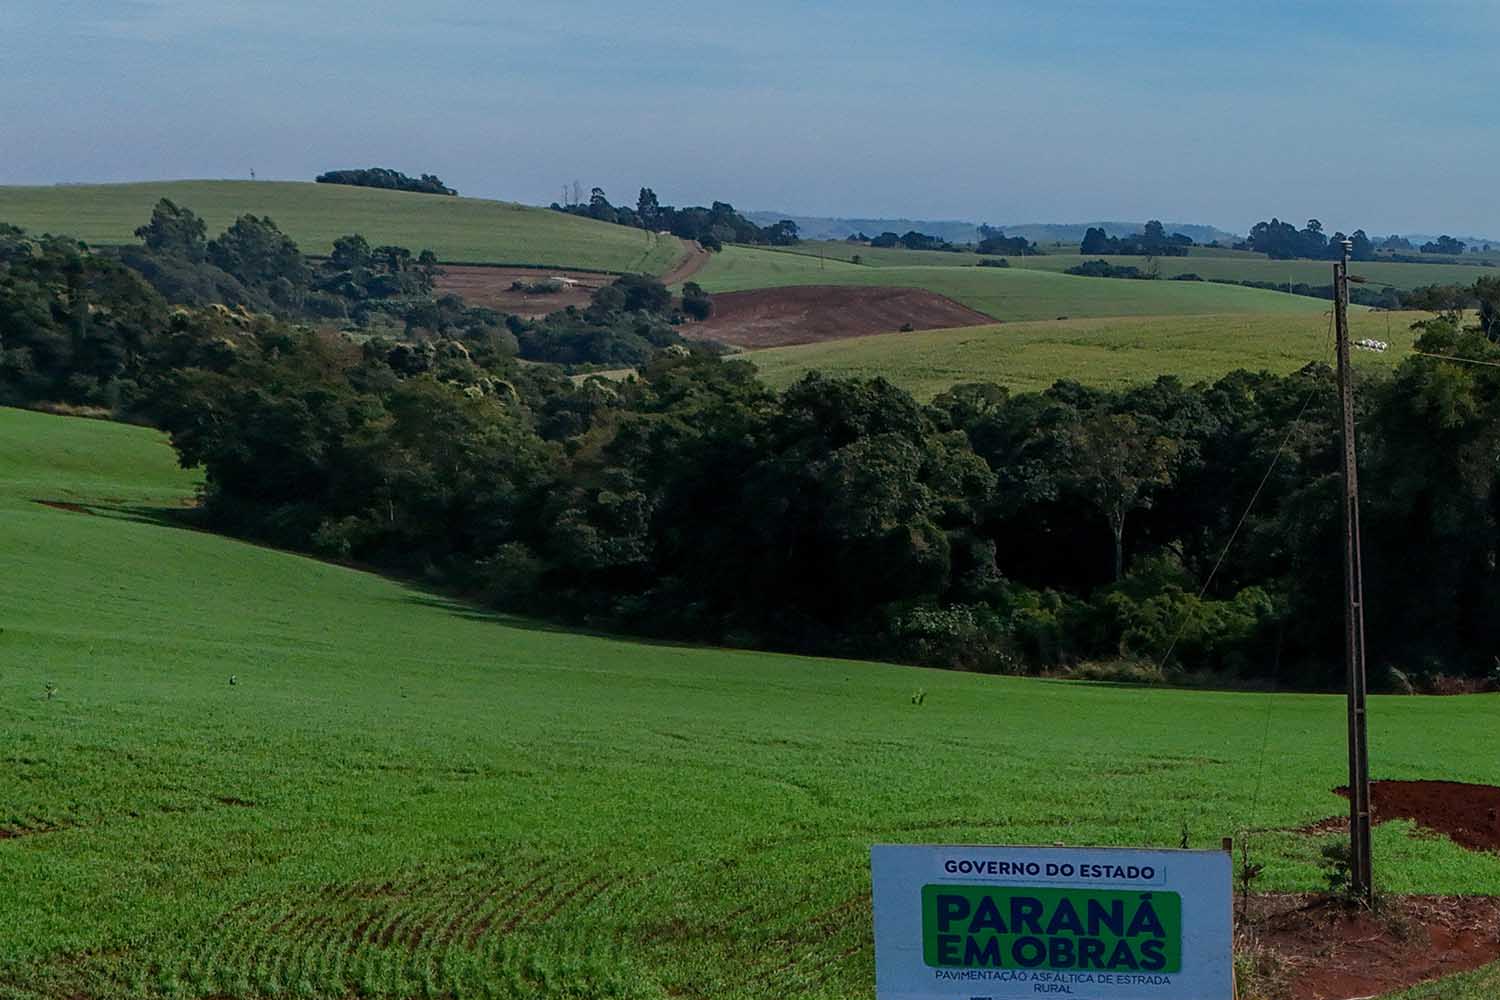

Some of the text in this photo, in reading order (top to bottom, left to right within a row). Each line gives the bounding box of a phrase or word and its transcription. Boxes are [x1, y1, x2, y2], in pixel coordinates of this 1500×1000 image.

[944, 859, 1155, 880] GOVERNO DO ESTADO
[936, 892, 1166, 938] PARANÁ
[936, 934, 1167, 972] EM OBRAS
[935, 970, 1171, 986] PAVIMENTAÇÃO ASFÁLTICA DE ESTRADA
[1033, 983, 1074, 995] RURAL
